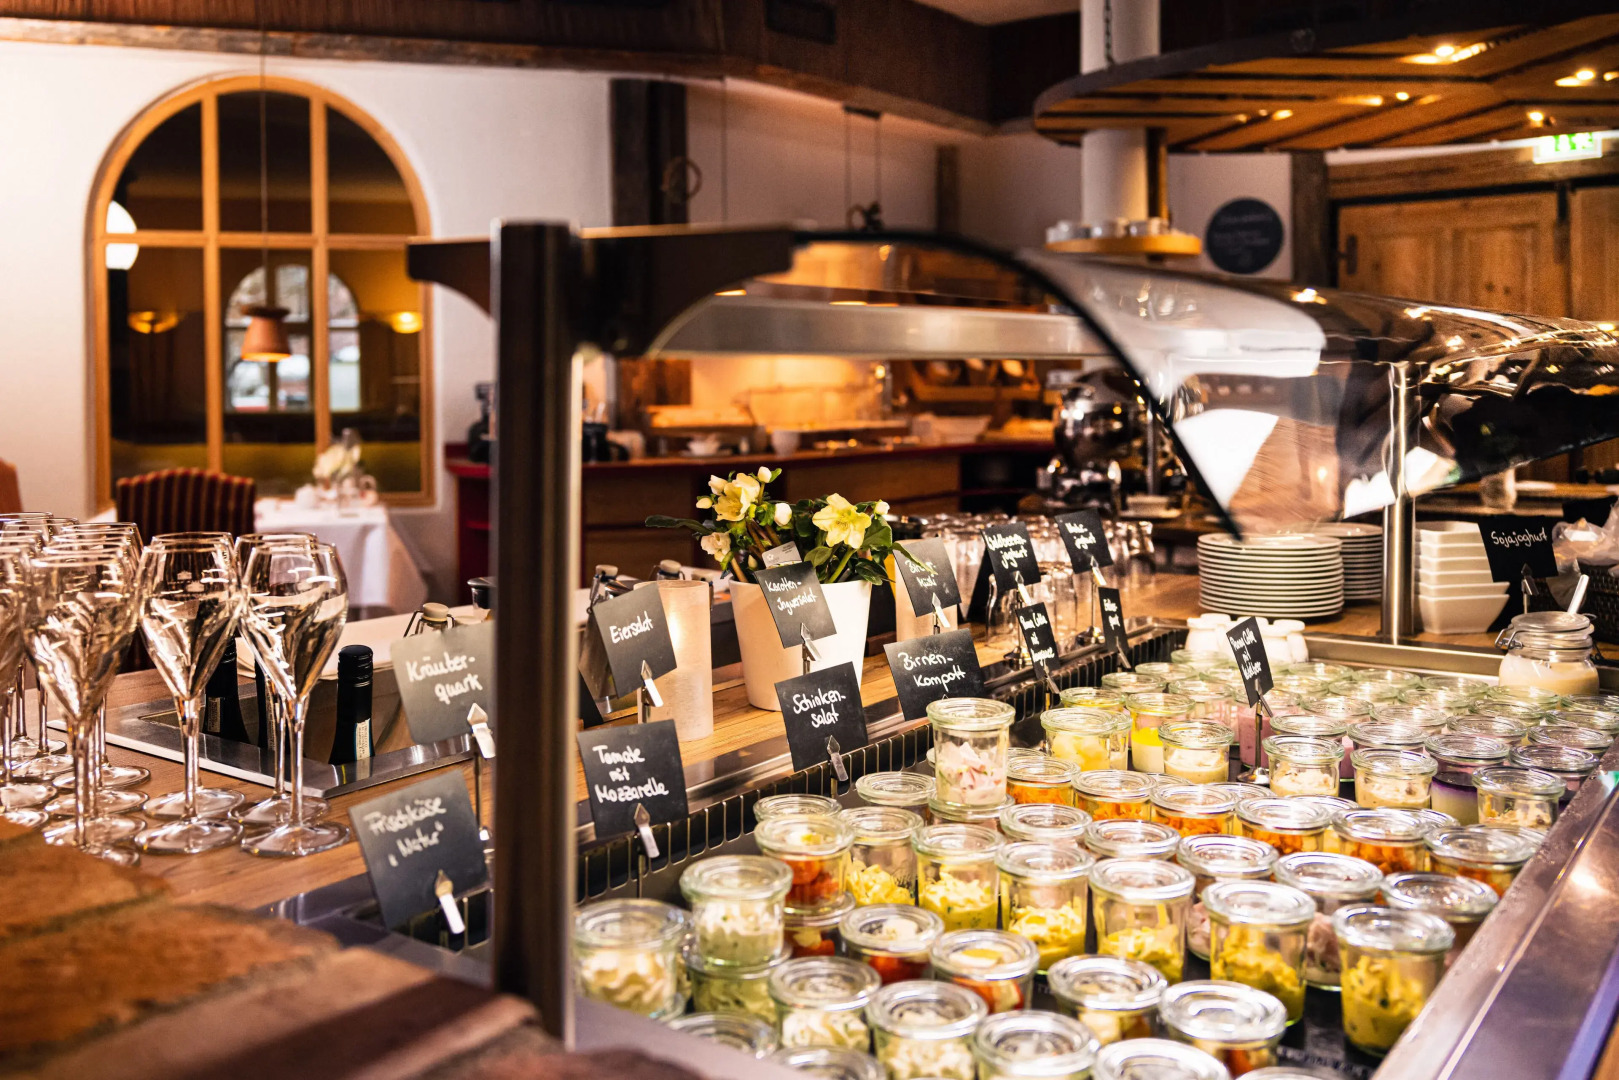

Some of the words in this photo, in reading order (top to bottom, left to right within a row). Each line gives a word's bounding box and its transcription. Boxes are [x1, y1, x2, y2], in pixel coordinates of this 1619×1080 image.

[1490, 527, 1548, 548] Sojajoghurt
[765, 577, 802, 592] Karotten-
[609, 610, 654, 644] Eiersalat
[405, 651, 476, 683] Kräuter-
[897, 652, 954, 671] Birnen-
[434, 673, 484, 705] quark
[913, 665, 967, 692] Kompott
[792, 687, 847, 714] Schinken-
[810, 703, 840, 729] salat
[592, 745, 646, 765] Tomate
[608, 765, 630, 782] mit
